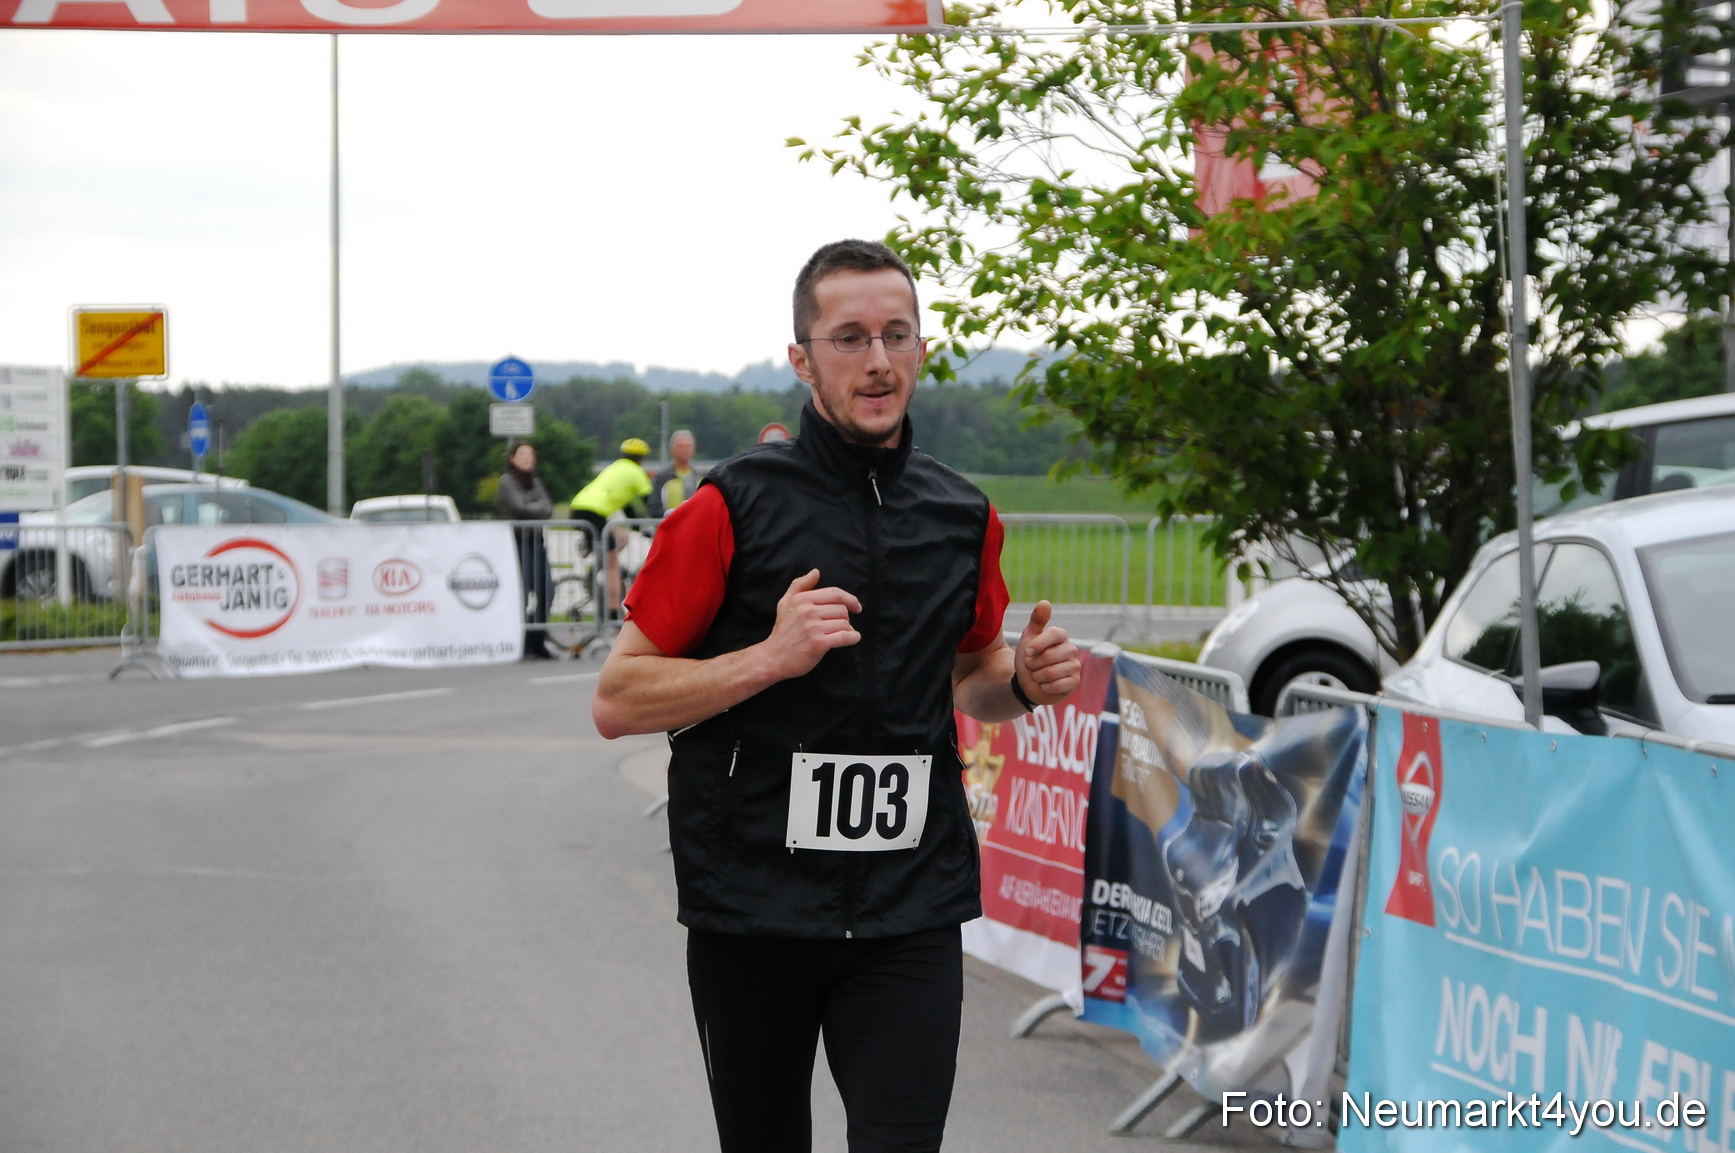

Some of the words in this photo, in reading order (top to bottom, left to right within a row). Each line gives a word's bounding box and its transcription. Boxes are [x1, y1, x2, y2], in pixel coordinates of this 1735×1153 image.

[171, 563, 273, 588] GERHART
[380, 567, 412, 587] KIA
[383, 600, 436, 615] MOTORS
[811, 762, 909, 840] 103
[1092, 878, 1133, 912] DER
[1436, 846, 1482, 935] SO
[1488, 855, 1650, 977] HABEN
[1657, 892, 1719, 1002] SIE
[1083, 950, 1118, 993] 7
[1434, 974, 1548, 1094] NOCH
